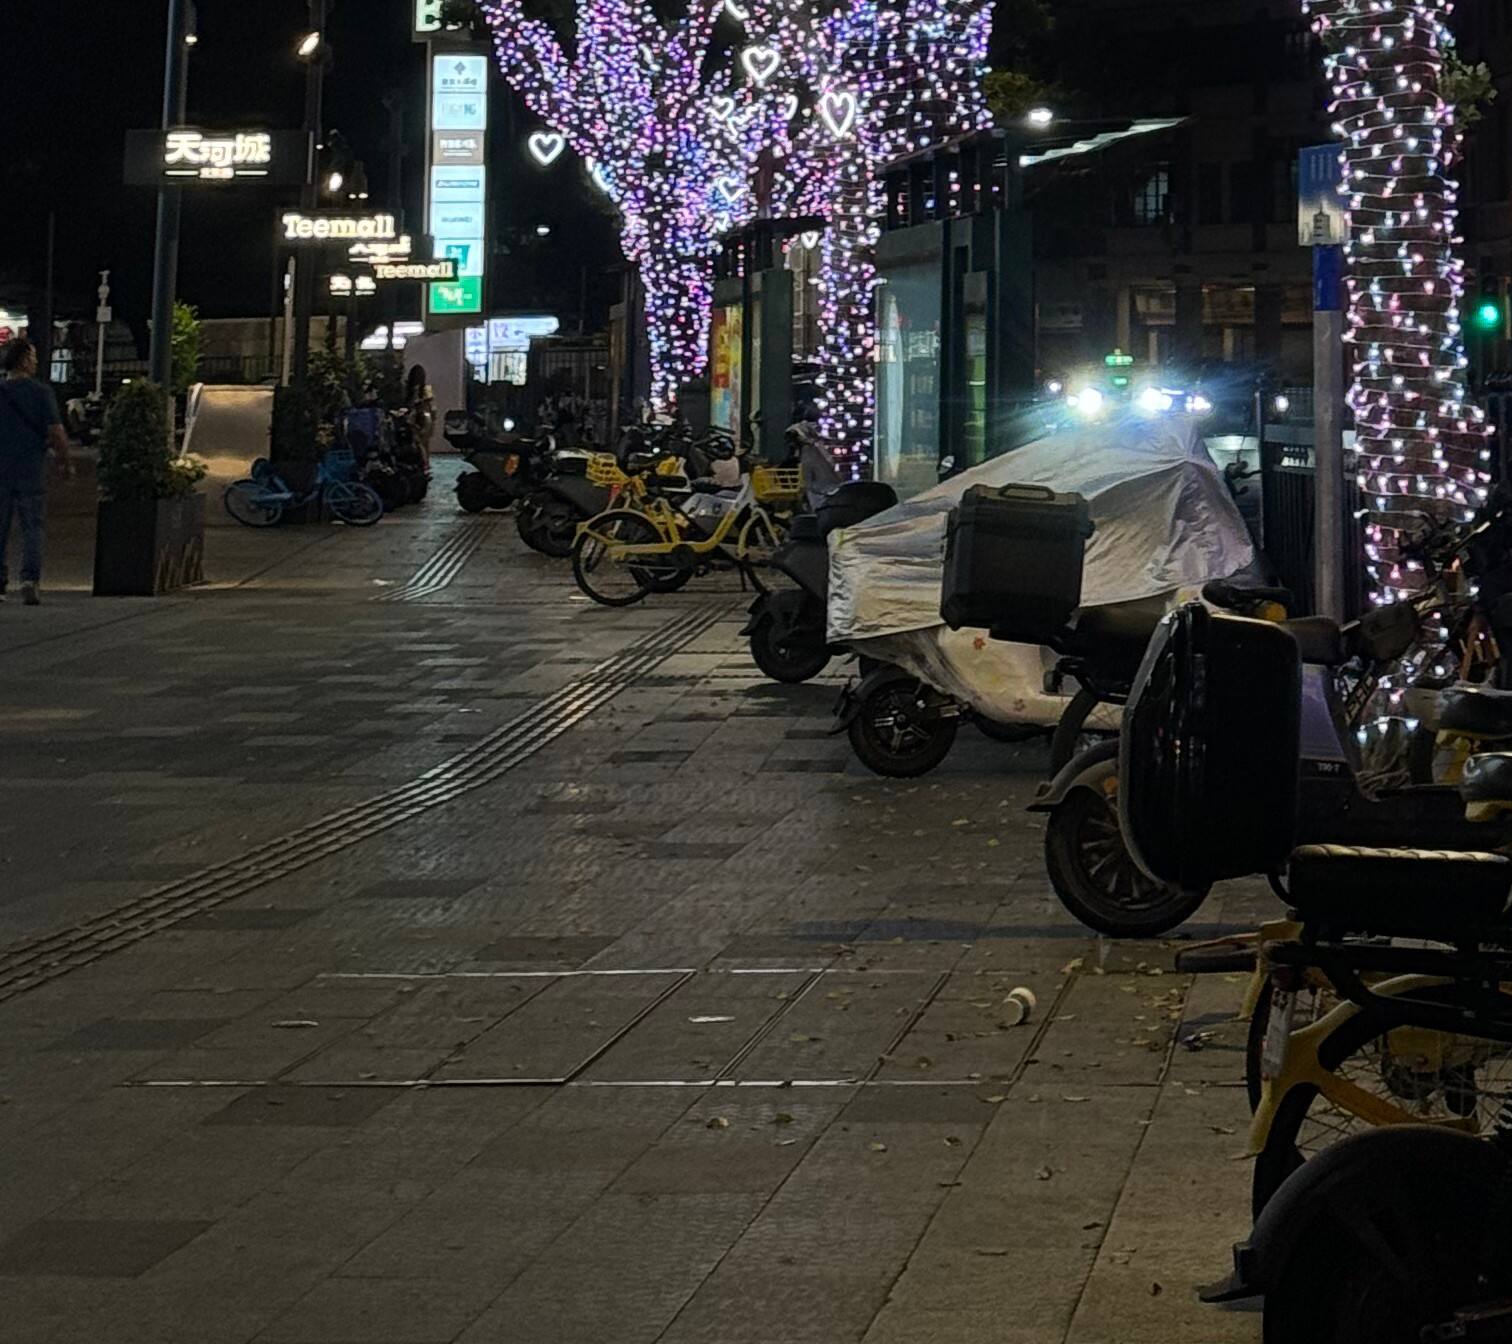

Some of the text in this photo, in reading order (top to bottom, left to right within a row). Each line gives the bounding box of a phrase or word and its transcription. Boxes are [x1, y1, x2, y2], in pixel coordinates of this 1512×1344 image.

[165, 131, 271, 167] 天河城
[282, 212, 395, 238] Teemall
[374, 261, 453, 279] Teemall
